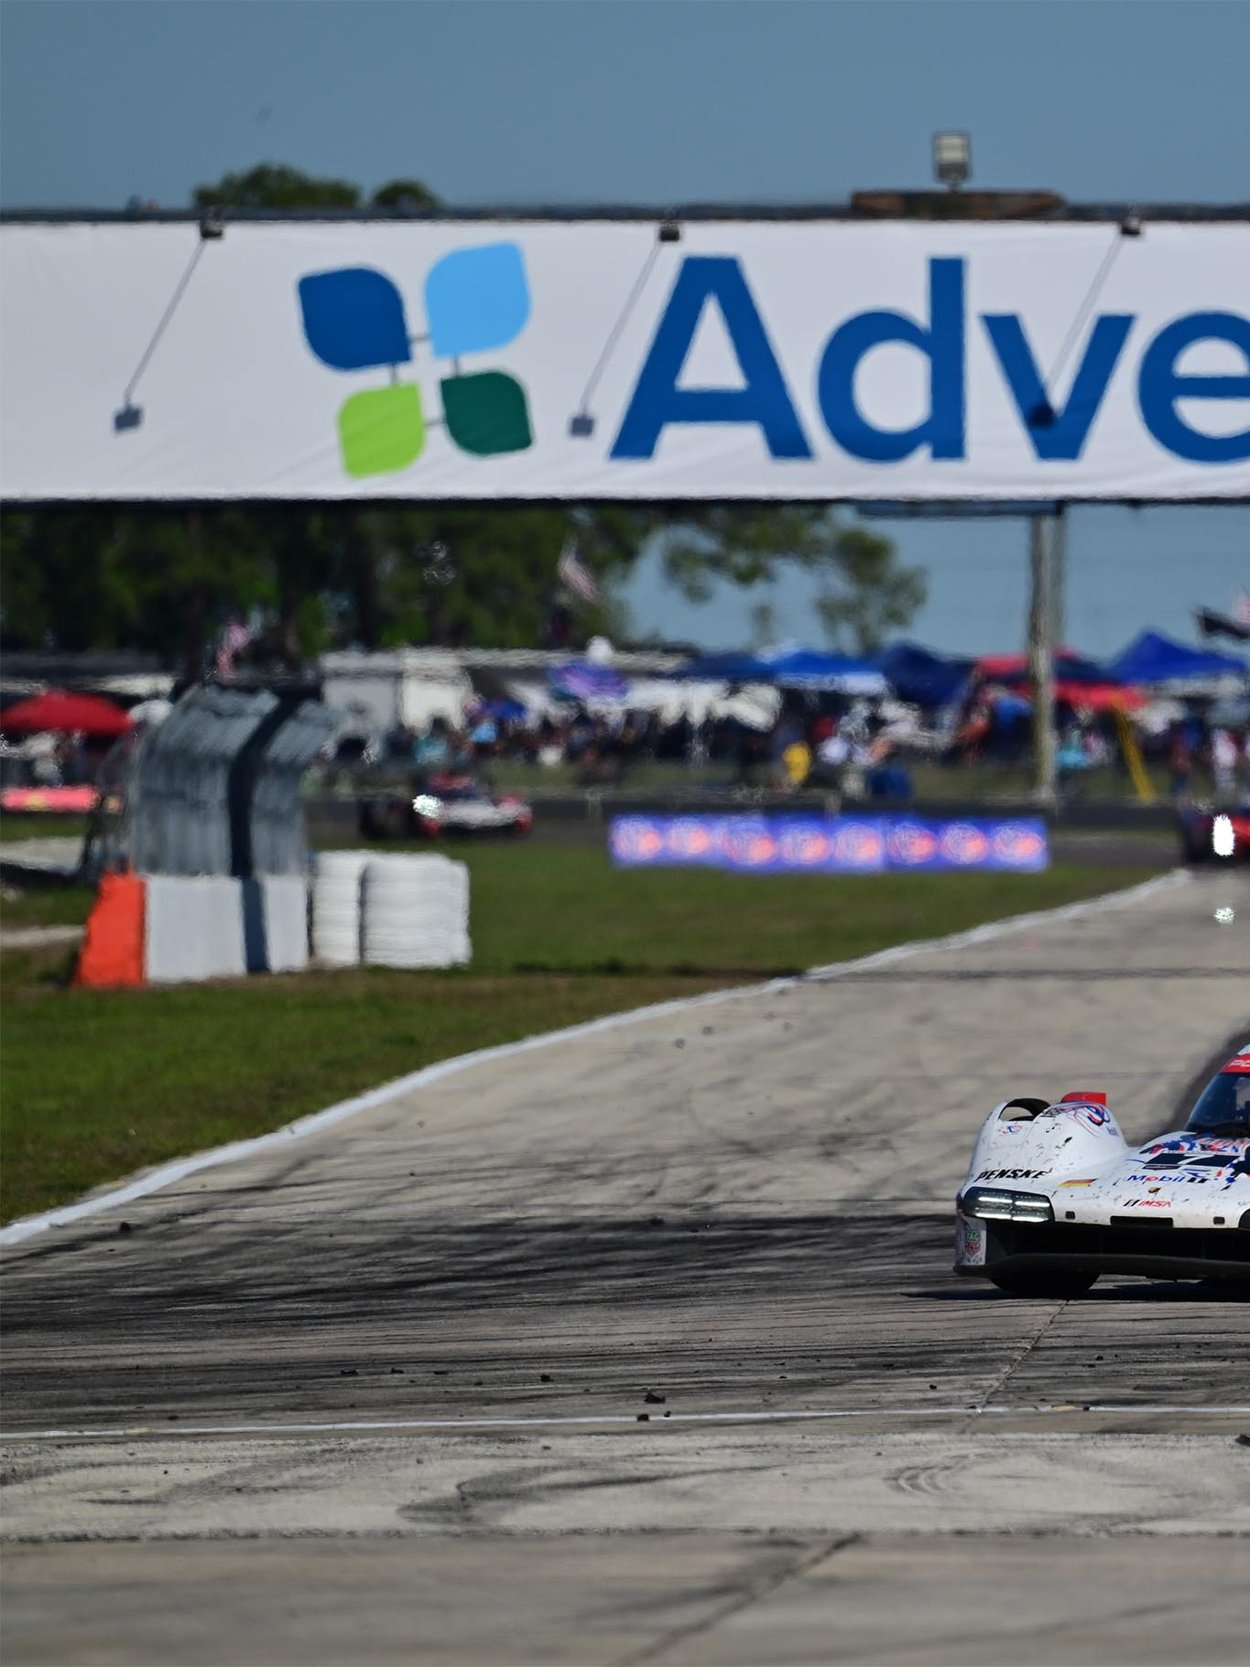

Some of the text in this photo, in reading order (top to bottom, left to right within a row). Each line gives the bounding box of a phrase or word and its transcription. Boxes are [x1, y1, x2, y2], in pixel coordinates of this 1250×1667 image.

[974, 1168, 1048, 1183] PENSKE
[1127, 1175, 1186, 1183] Mobil
[1137, 1200, 1172, 1208] IMSA
